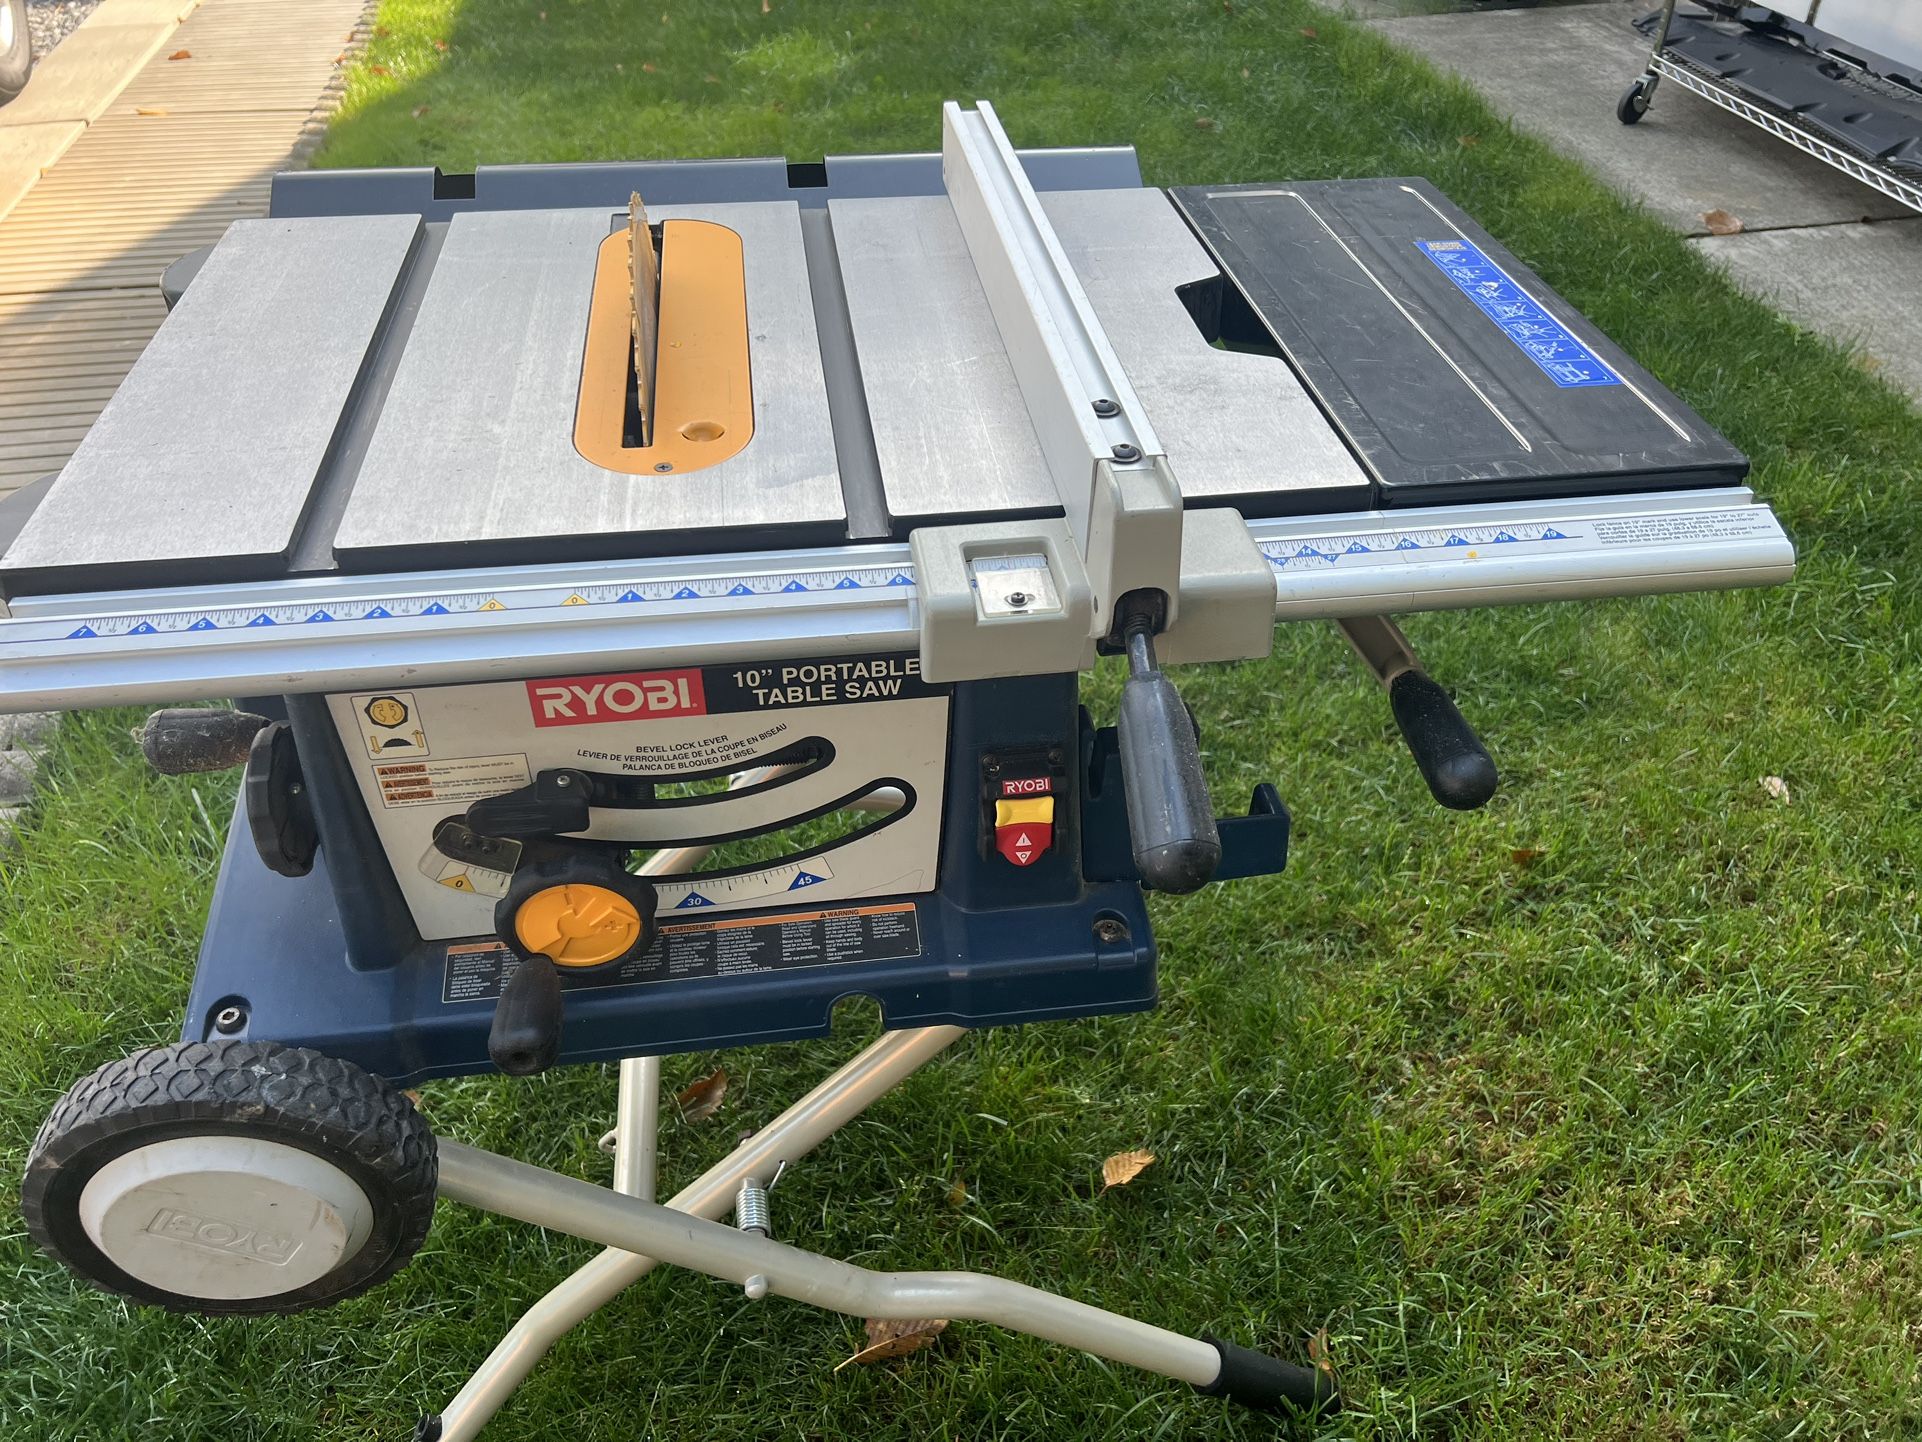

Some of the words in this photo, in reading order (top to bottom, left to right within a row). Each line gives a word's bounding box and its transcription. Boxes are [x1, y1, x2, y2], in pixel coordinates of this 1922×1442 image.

[1301, 547, 1312, 556] 14
[1350, 544, 1361, 552] 15
[1400, 541, 1411, 549] 16
[1449, 537, 1460, 545] 17
[1498, 534, 1509, 542] 18
[782, 658, 921, 685] PORTABLE
[535, 678, 691, 719] RYOBI
[752, 683, 837, 706] TABLE
[845, 678, 902, 699] SAW
[577, 748, 608, 760] LEVIER
[610, 753, 622, 762] DE
[624, 753, 691, 763] VERROUILLAGE
[691, 749, 703, 759] DE
[704, 746, 716, 756] LA
[717, 739, 746, 753] COUPE
[746, 735, 758, 746] EN
[758, 722, 787, 741] BISEAU
[635, 745, 667, 754] BEVEL
[669, 741, 696, 752] LOCK
[698, 734, 729, 748] LEVER
[387, 764, 426, 776] WARNING
[622, 762, 662, 771] PALANCA
[664, 761, 677, 770] DE
[677, 757, 719, 770] BLOQUEO
[720, 753, 732, 763] DE
[733, 747, 758, 759] BISEL
[1005, 778, 1048, 794] RYOBI
[455, 879, 463, 888] 0
[687, 898, 702, 906] 30
[798, 876, 813, 886] 45
[827, 908, 859, 918] WARNING
[667, 922, 716, 934] AVERTISSEMENT
